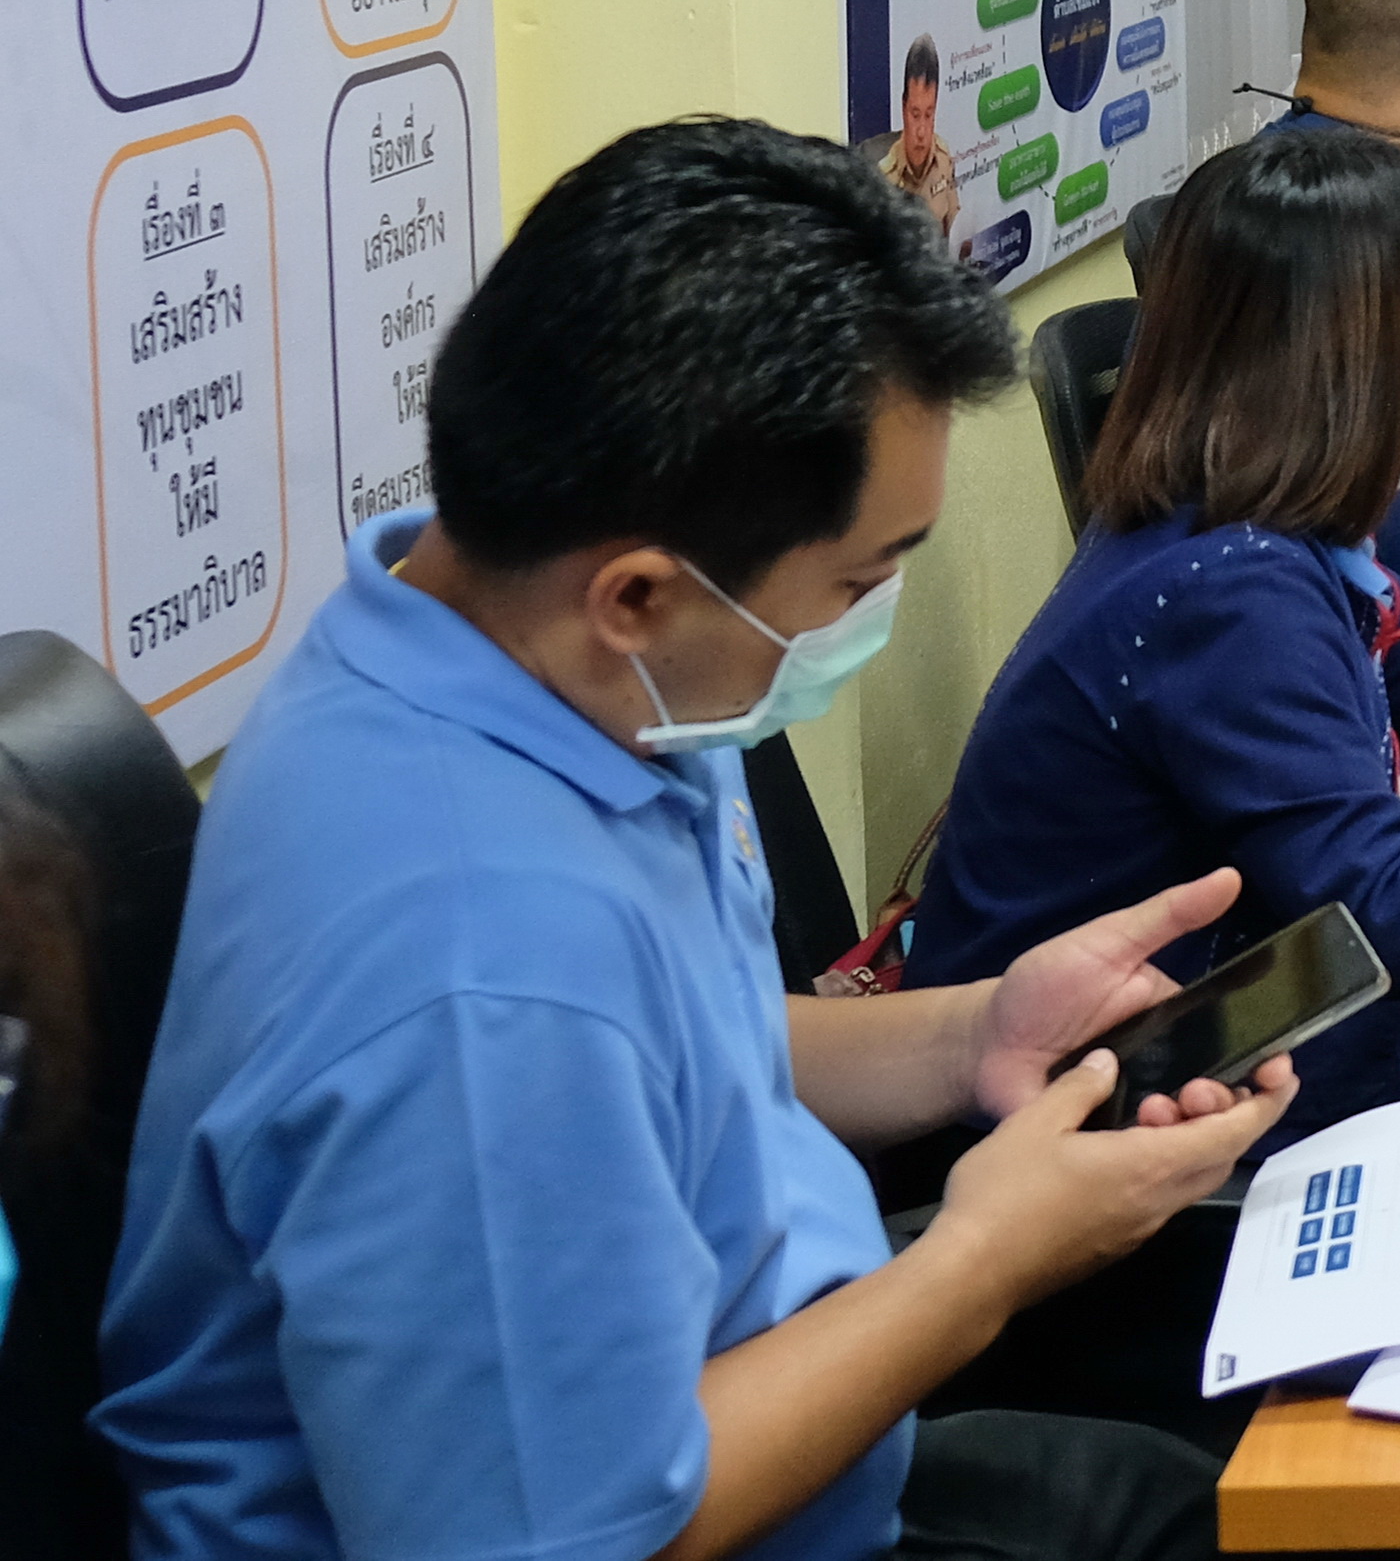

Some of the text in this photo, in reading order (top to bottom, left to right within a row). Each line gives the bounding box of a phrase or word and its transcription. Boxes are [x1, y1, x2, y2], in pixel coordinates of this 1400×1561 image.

[368, 102, 436, 178] เรื่องที่ ๔
[142, 169, 227, 254] เรื่องที่ ๓
[364, 196, 446, 275] เสริมสร้าง
[130, 268, 243, 366] เสริมสร้าง
[381, 280, 436, 350] องค์กร
[136, 369, 244, 474] ทุนชุมชน
[393, 359, 432, 426] ให้มี
[168, 455, 220, 540] ให้มี
[127, 548, 267, 661] ธรรมาภิบาล
